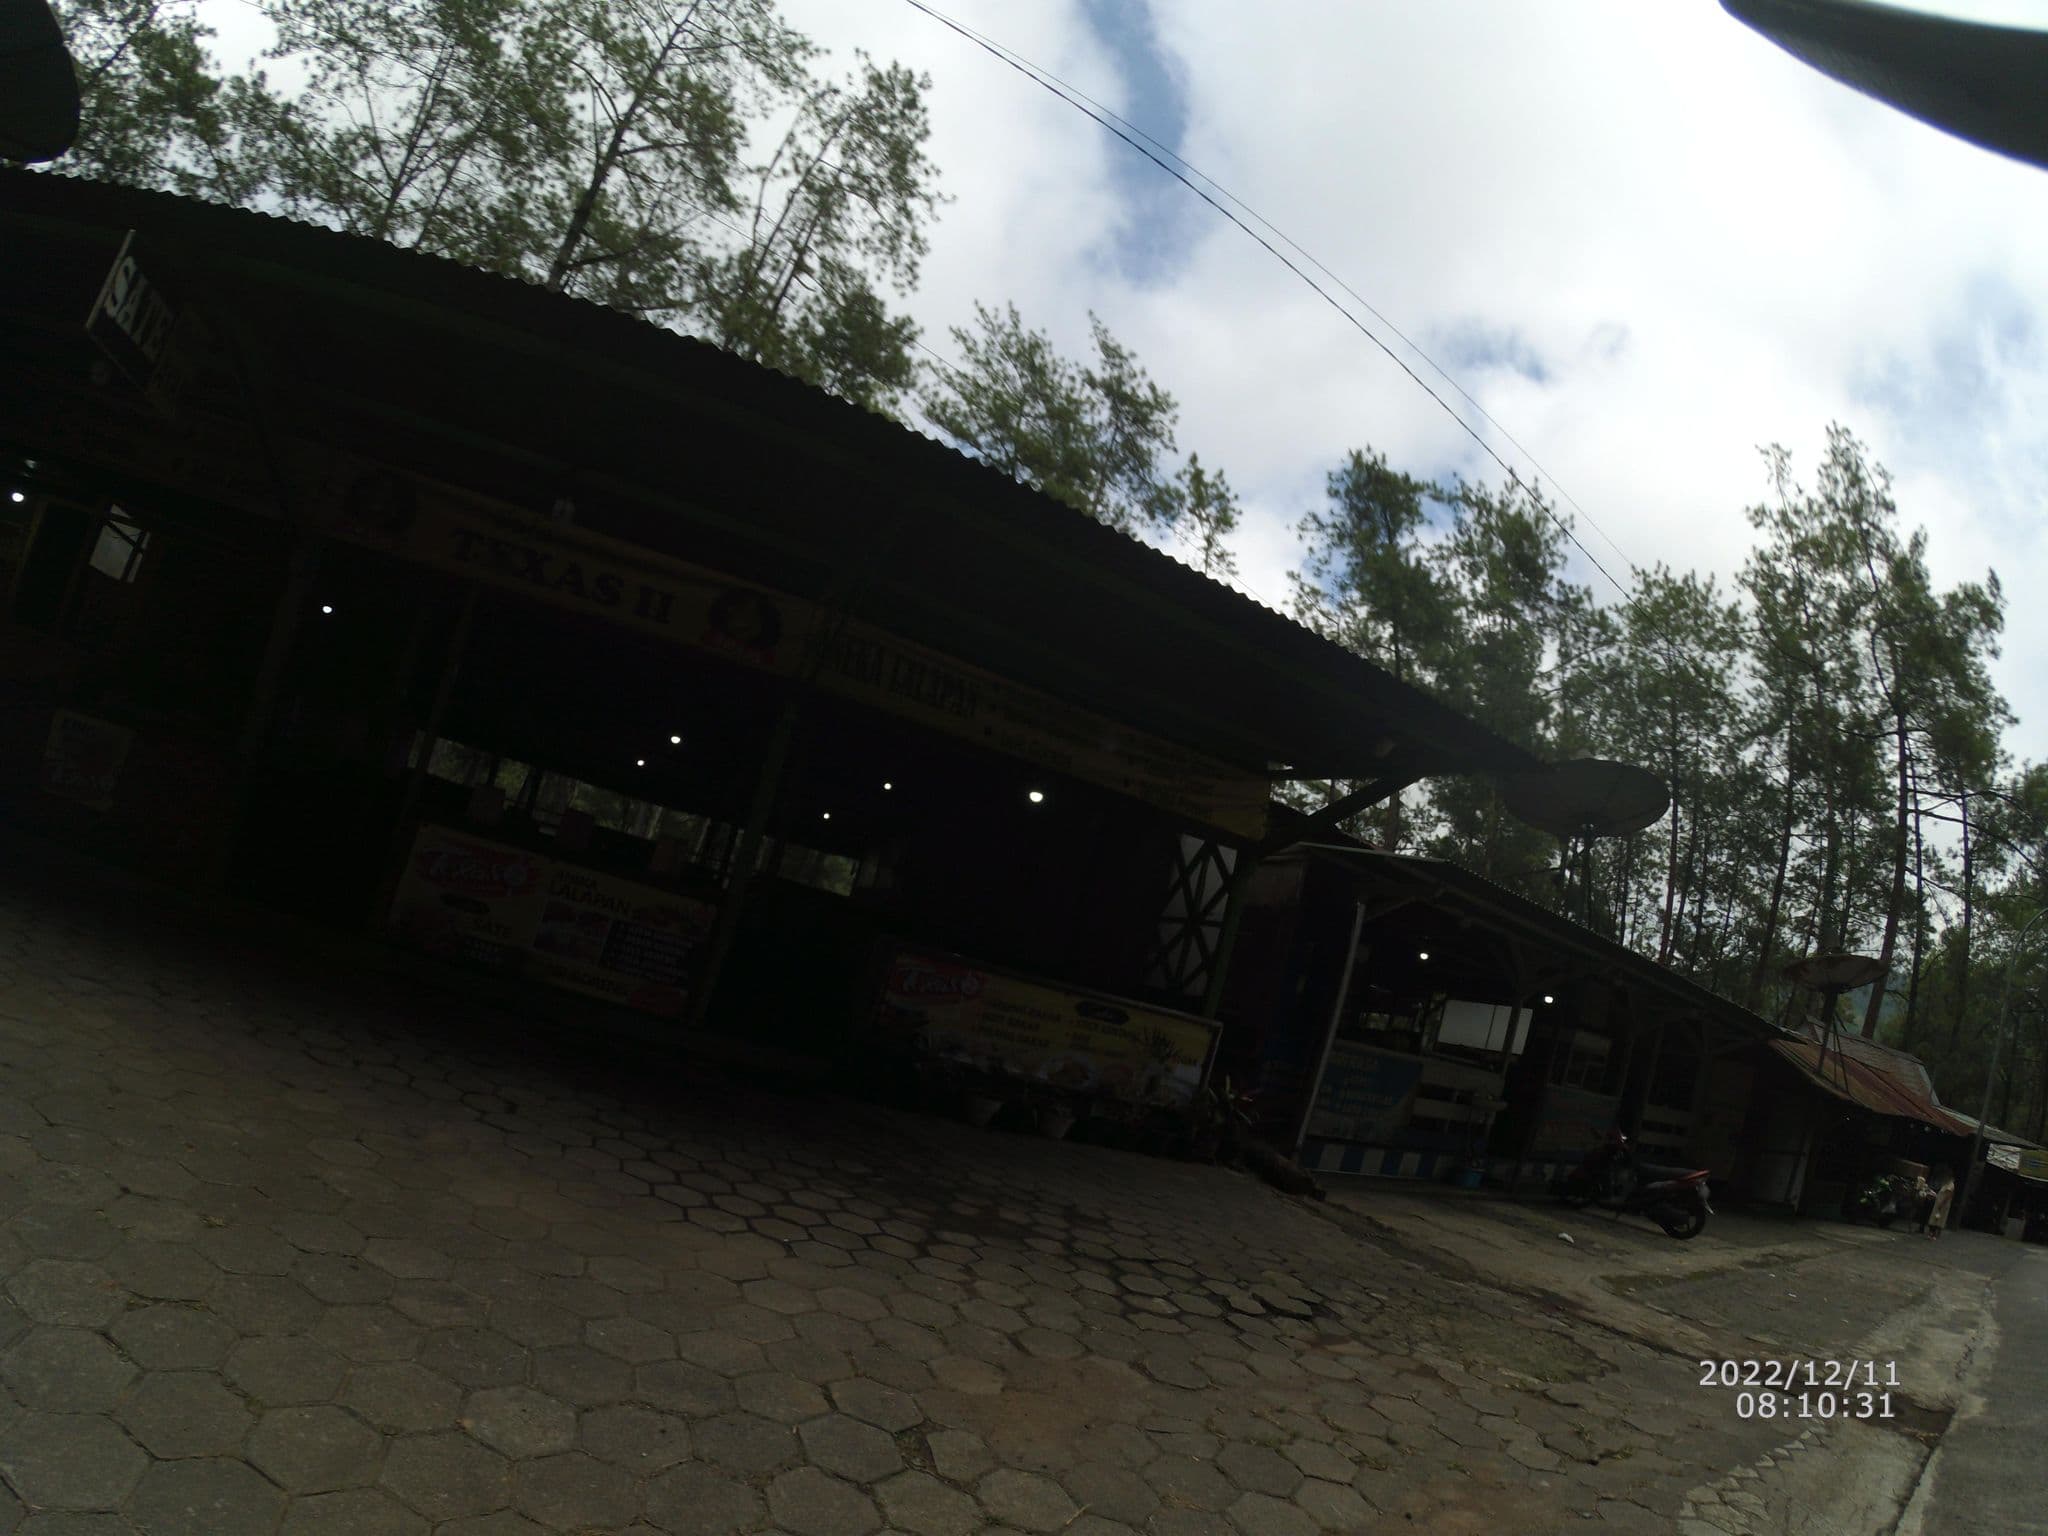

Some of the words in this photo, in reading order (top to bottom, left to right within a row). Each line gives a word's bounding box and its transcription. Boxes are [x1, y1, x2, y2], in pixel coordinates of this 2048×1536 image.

[104, 256, 176, 365] SATE
[449, 528, 625, 607] TEXAS
[632, 585, 678, 624] II
[548, 879, 633, 915] LALAPAN
